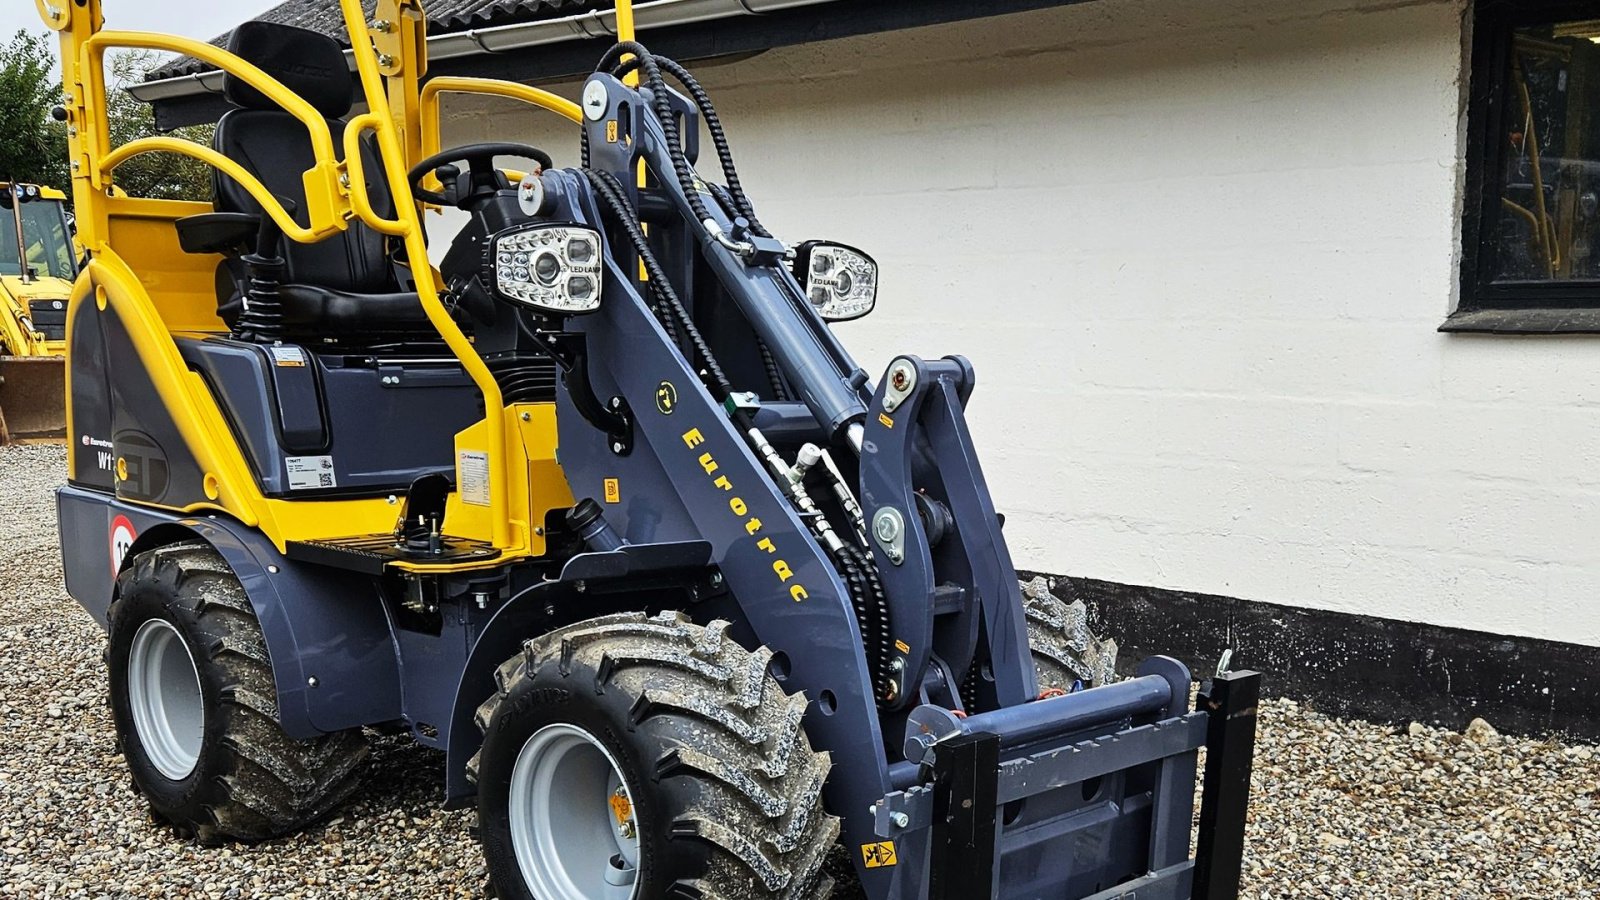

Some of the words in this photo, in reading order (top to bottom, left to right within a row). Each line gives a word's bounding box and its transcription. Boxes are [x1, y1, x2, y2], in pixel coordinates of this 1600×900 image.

[90, 437, 114, 448] Eurotra
[97, 450, 115, 471] W1
[681, 426, 809, 603] Eurotrac
